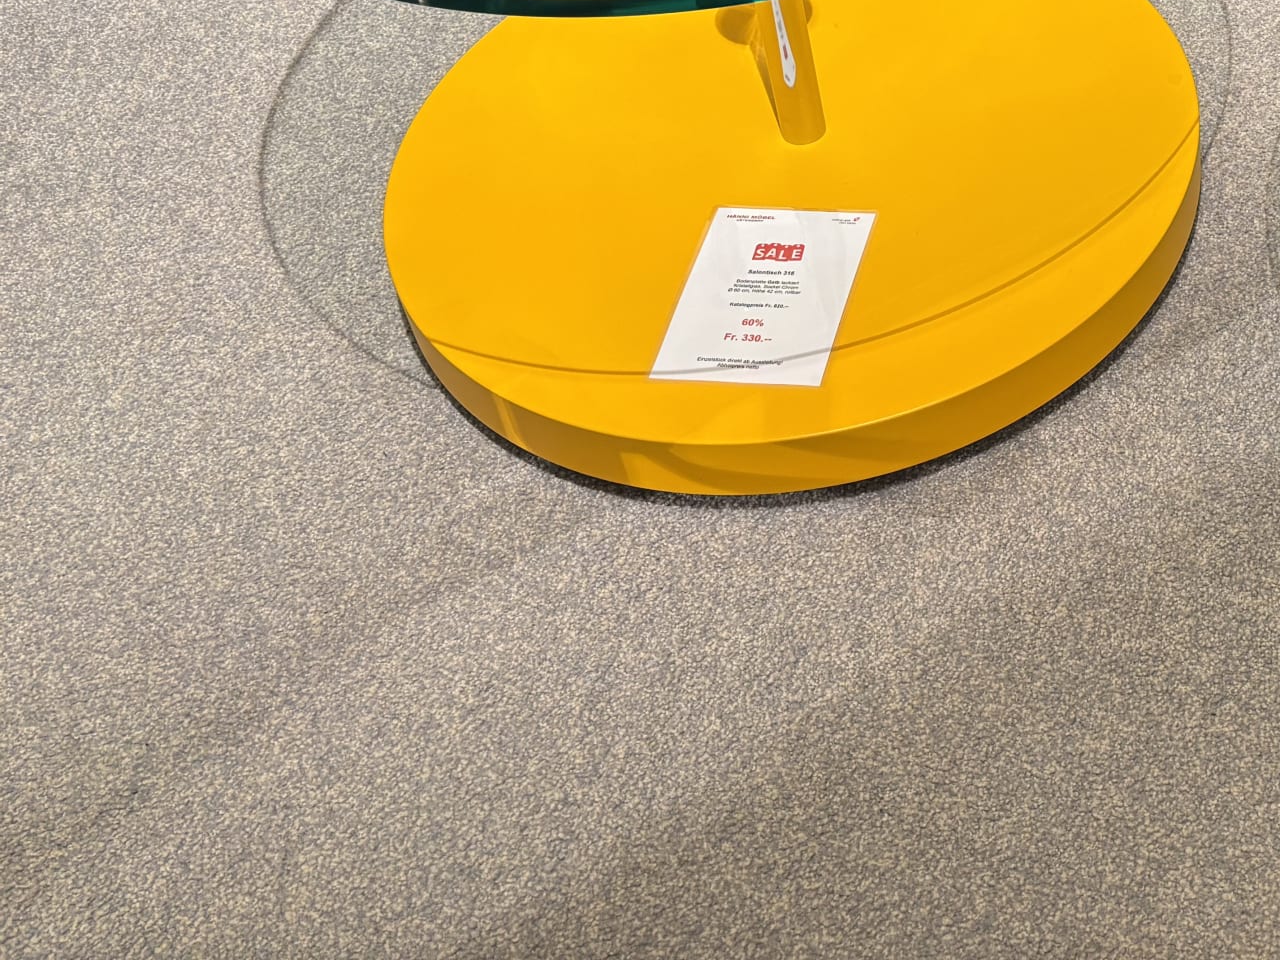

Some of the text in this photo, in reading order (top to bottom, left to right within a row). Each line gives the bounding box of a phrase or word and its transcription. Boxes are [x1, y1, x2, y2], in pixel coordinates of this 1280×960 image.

[754, 248, 802, 260] SALE
[742, 318, 764, 327] 60%
[724, 333, 738, 341] Fr.
